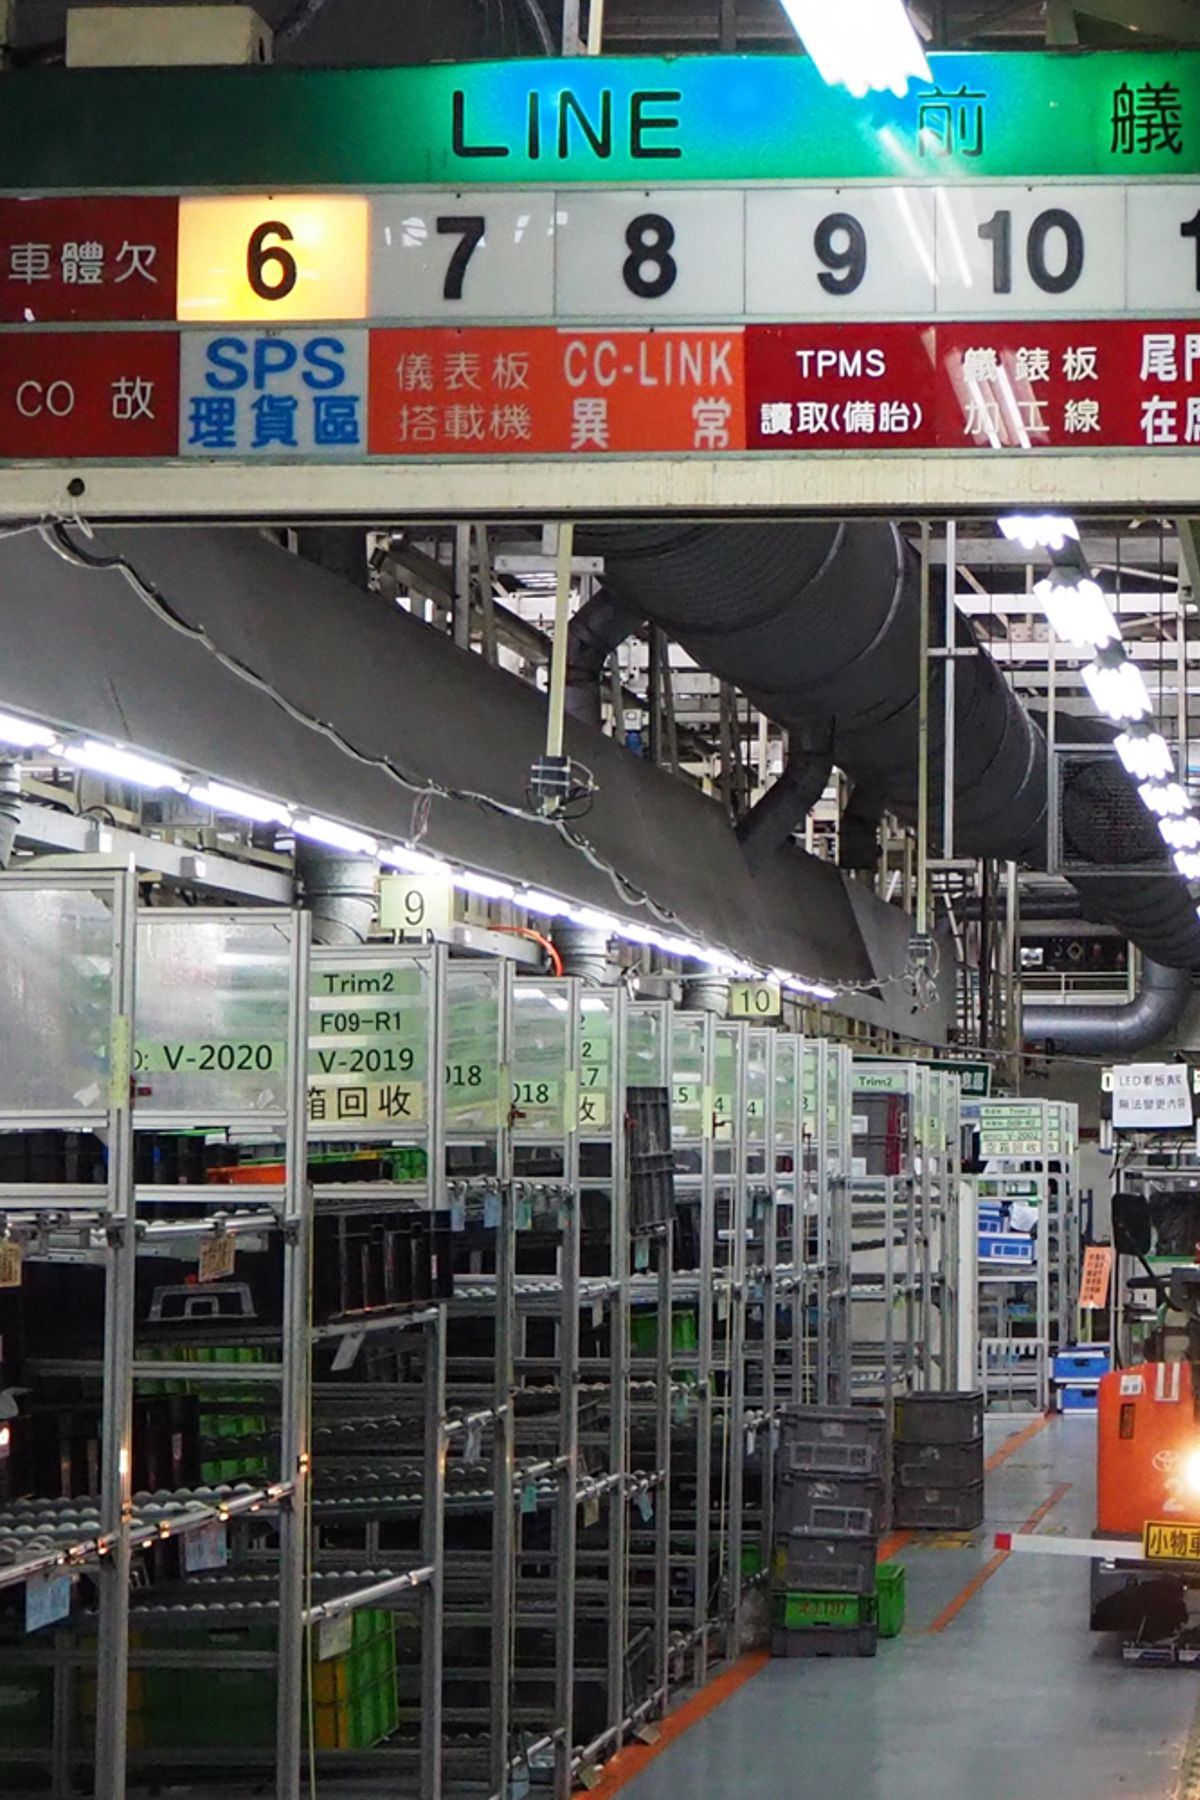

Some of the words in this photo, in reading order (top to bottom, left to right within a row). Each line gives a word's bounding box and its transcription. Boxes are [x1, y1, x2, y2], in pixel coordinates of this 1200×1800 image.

[452, 90, 682, 158] LINE
[8, 241, 157, 285] 車體欠
[247, 221, 297, 300] 6
[436, 216, 486, 300] 7
[622, 213, 677, 299] 8
[813, 213, 868, 295] 9
[977, 208, 1084, 294] 10
[205, 337, 346, 391] SPS
[395, 352, 531, 393] 儀表板
[564, 340, 734, 387] CC-LINK
[796, 349, 886, 378] TPMS
[188, 395, 361, 449] 理貨區
[398, 403, 532, 441] 搭載機
[760, 402, 923, 435] 讀取(備胎)
[405, 890, 424, 925] 9
[323, 972, 394, 993] Trim2
[741, 989, 770, 1014] 10
[320, 1011, 401, 1033] F09-R1
[163, 1044, 273, 1070] V-2020
[318, 1048, 414, 1073] V-2019
